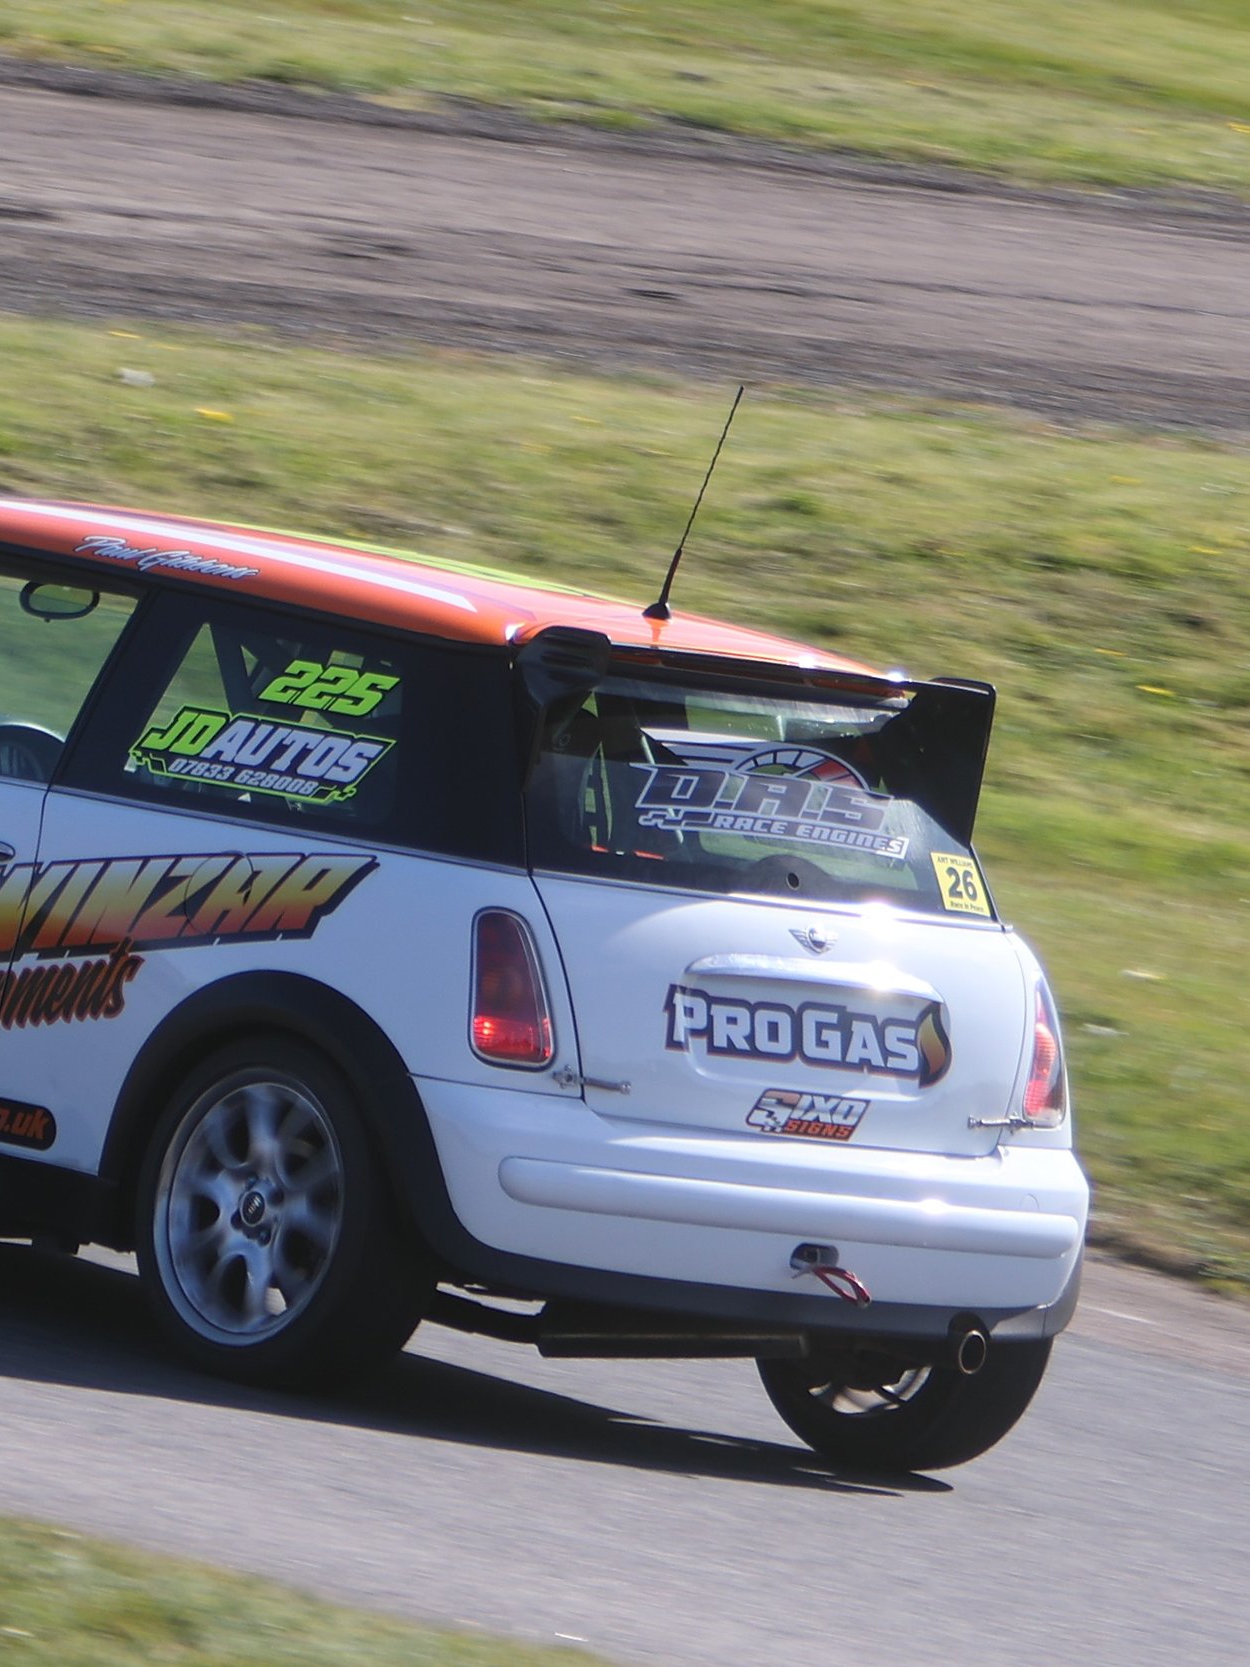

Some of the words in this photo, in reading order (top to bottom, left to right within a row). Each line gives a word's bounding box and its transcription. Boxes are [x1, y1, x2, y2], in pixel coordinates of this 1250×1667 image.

[73, 535, 157, 561] Paul
[136, 550, 261, 580] Gibbons
[259, 659, 401, 718] 225
[168, 758, 235, 780] 07833
[234, 769, 320, 795] 628008
[713, 815, 788, 835] RACE
[796, 823, 903, 854] ENGINES
[945, 866, 978, 902] 26
[784, 1120, 851, 1138] SIGNS
